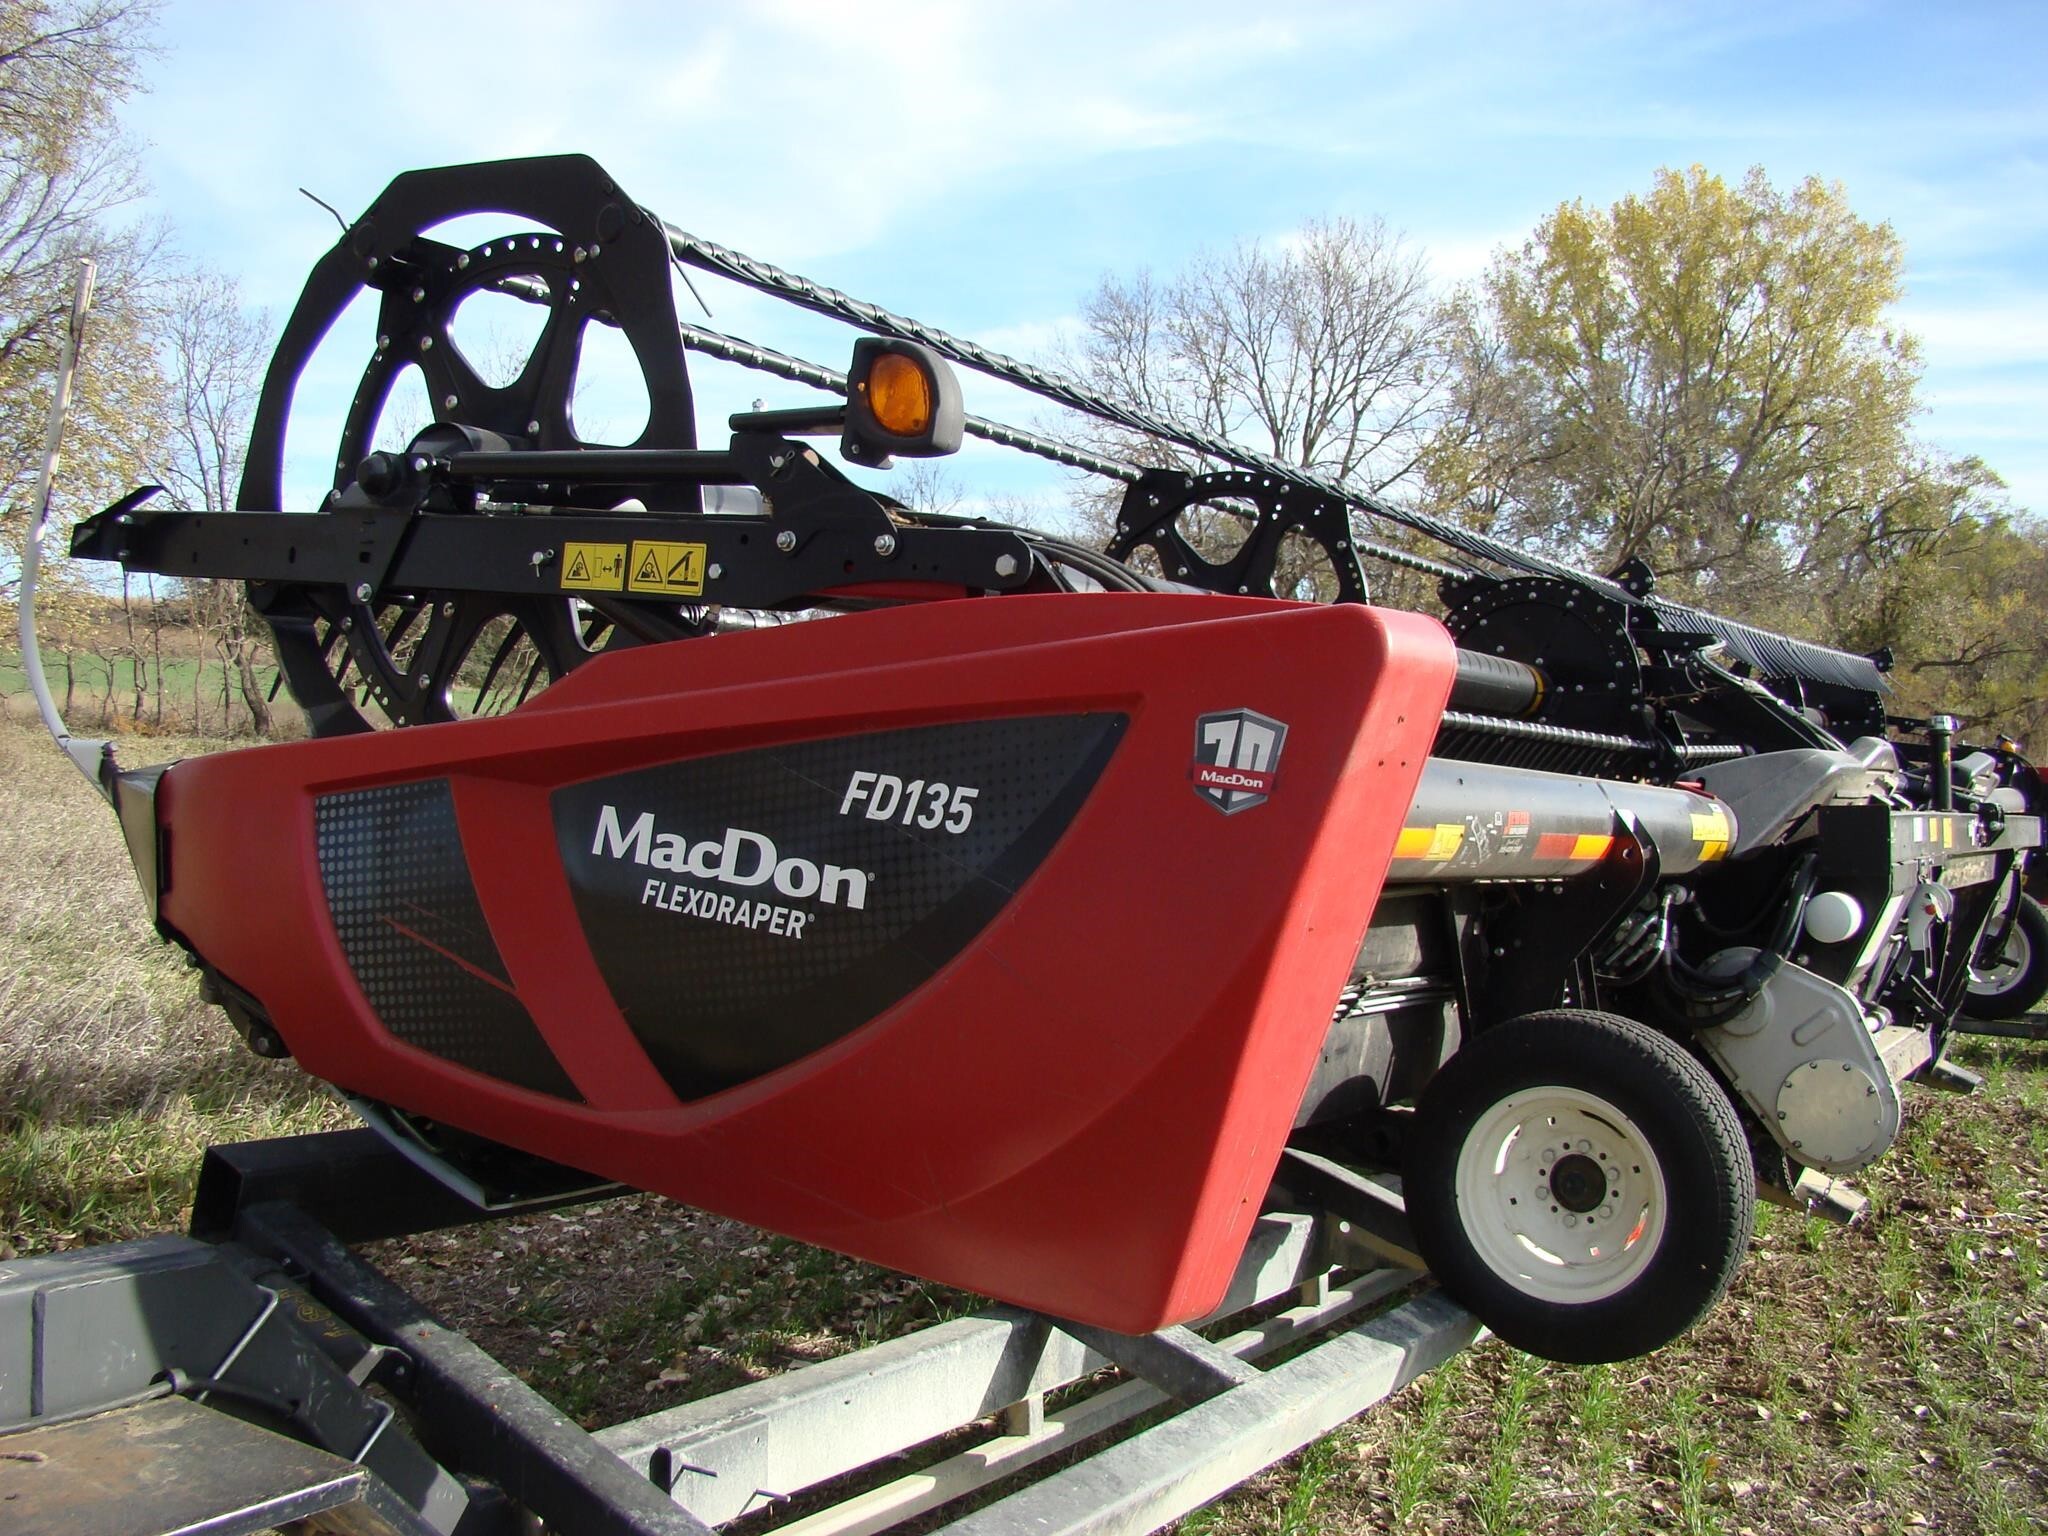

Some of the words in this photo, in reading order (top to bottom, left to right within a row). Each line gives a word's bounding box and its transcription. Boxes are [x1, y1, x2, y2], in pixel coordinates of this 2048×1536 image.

[839, 770, 979, 834] FD135
[1201, 769, 1263, 788] MacDon
[592, 804, 868, 910] MacDon
[641, 878, 807, 939] FLEXDRAPER
